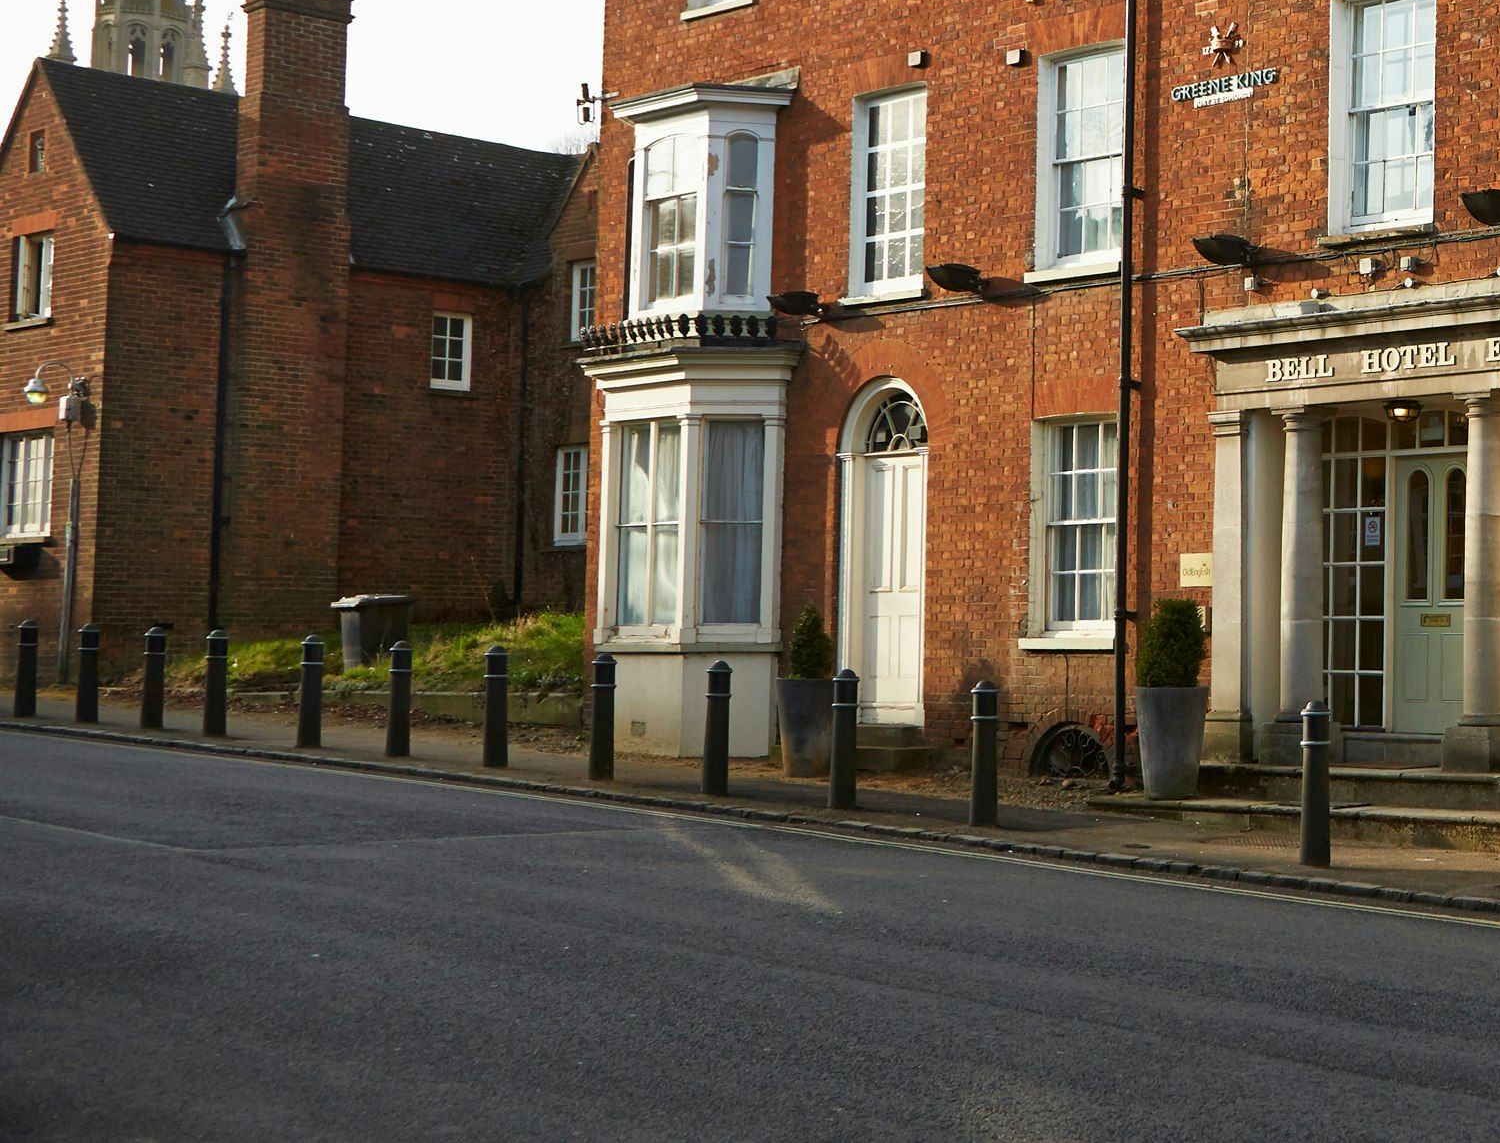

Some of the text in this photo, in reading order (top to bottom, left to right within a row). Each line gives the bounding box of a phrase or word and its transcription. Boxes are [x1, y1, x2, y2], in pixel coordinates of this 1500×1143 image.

[1171, 78, 1232, 101] GREENE
[1235, 67, 1277, 90] KING
[1265, 354, 1335, 383] BELL
[1360, 341, 1456, 374] HOTEL
